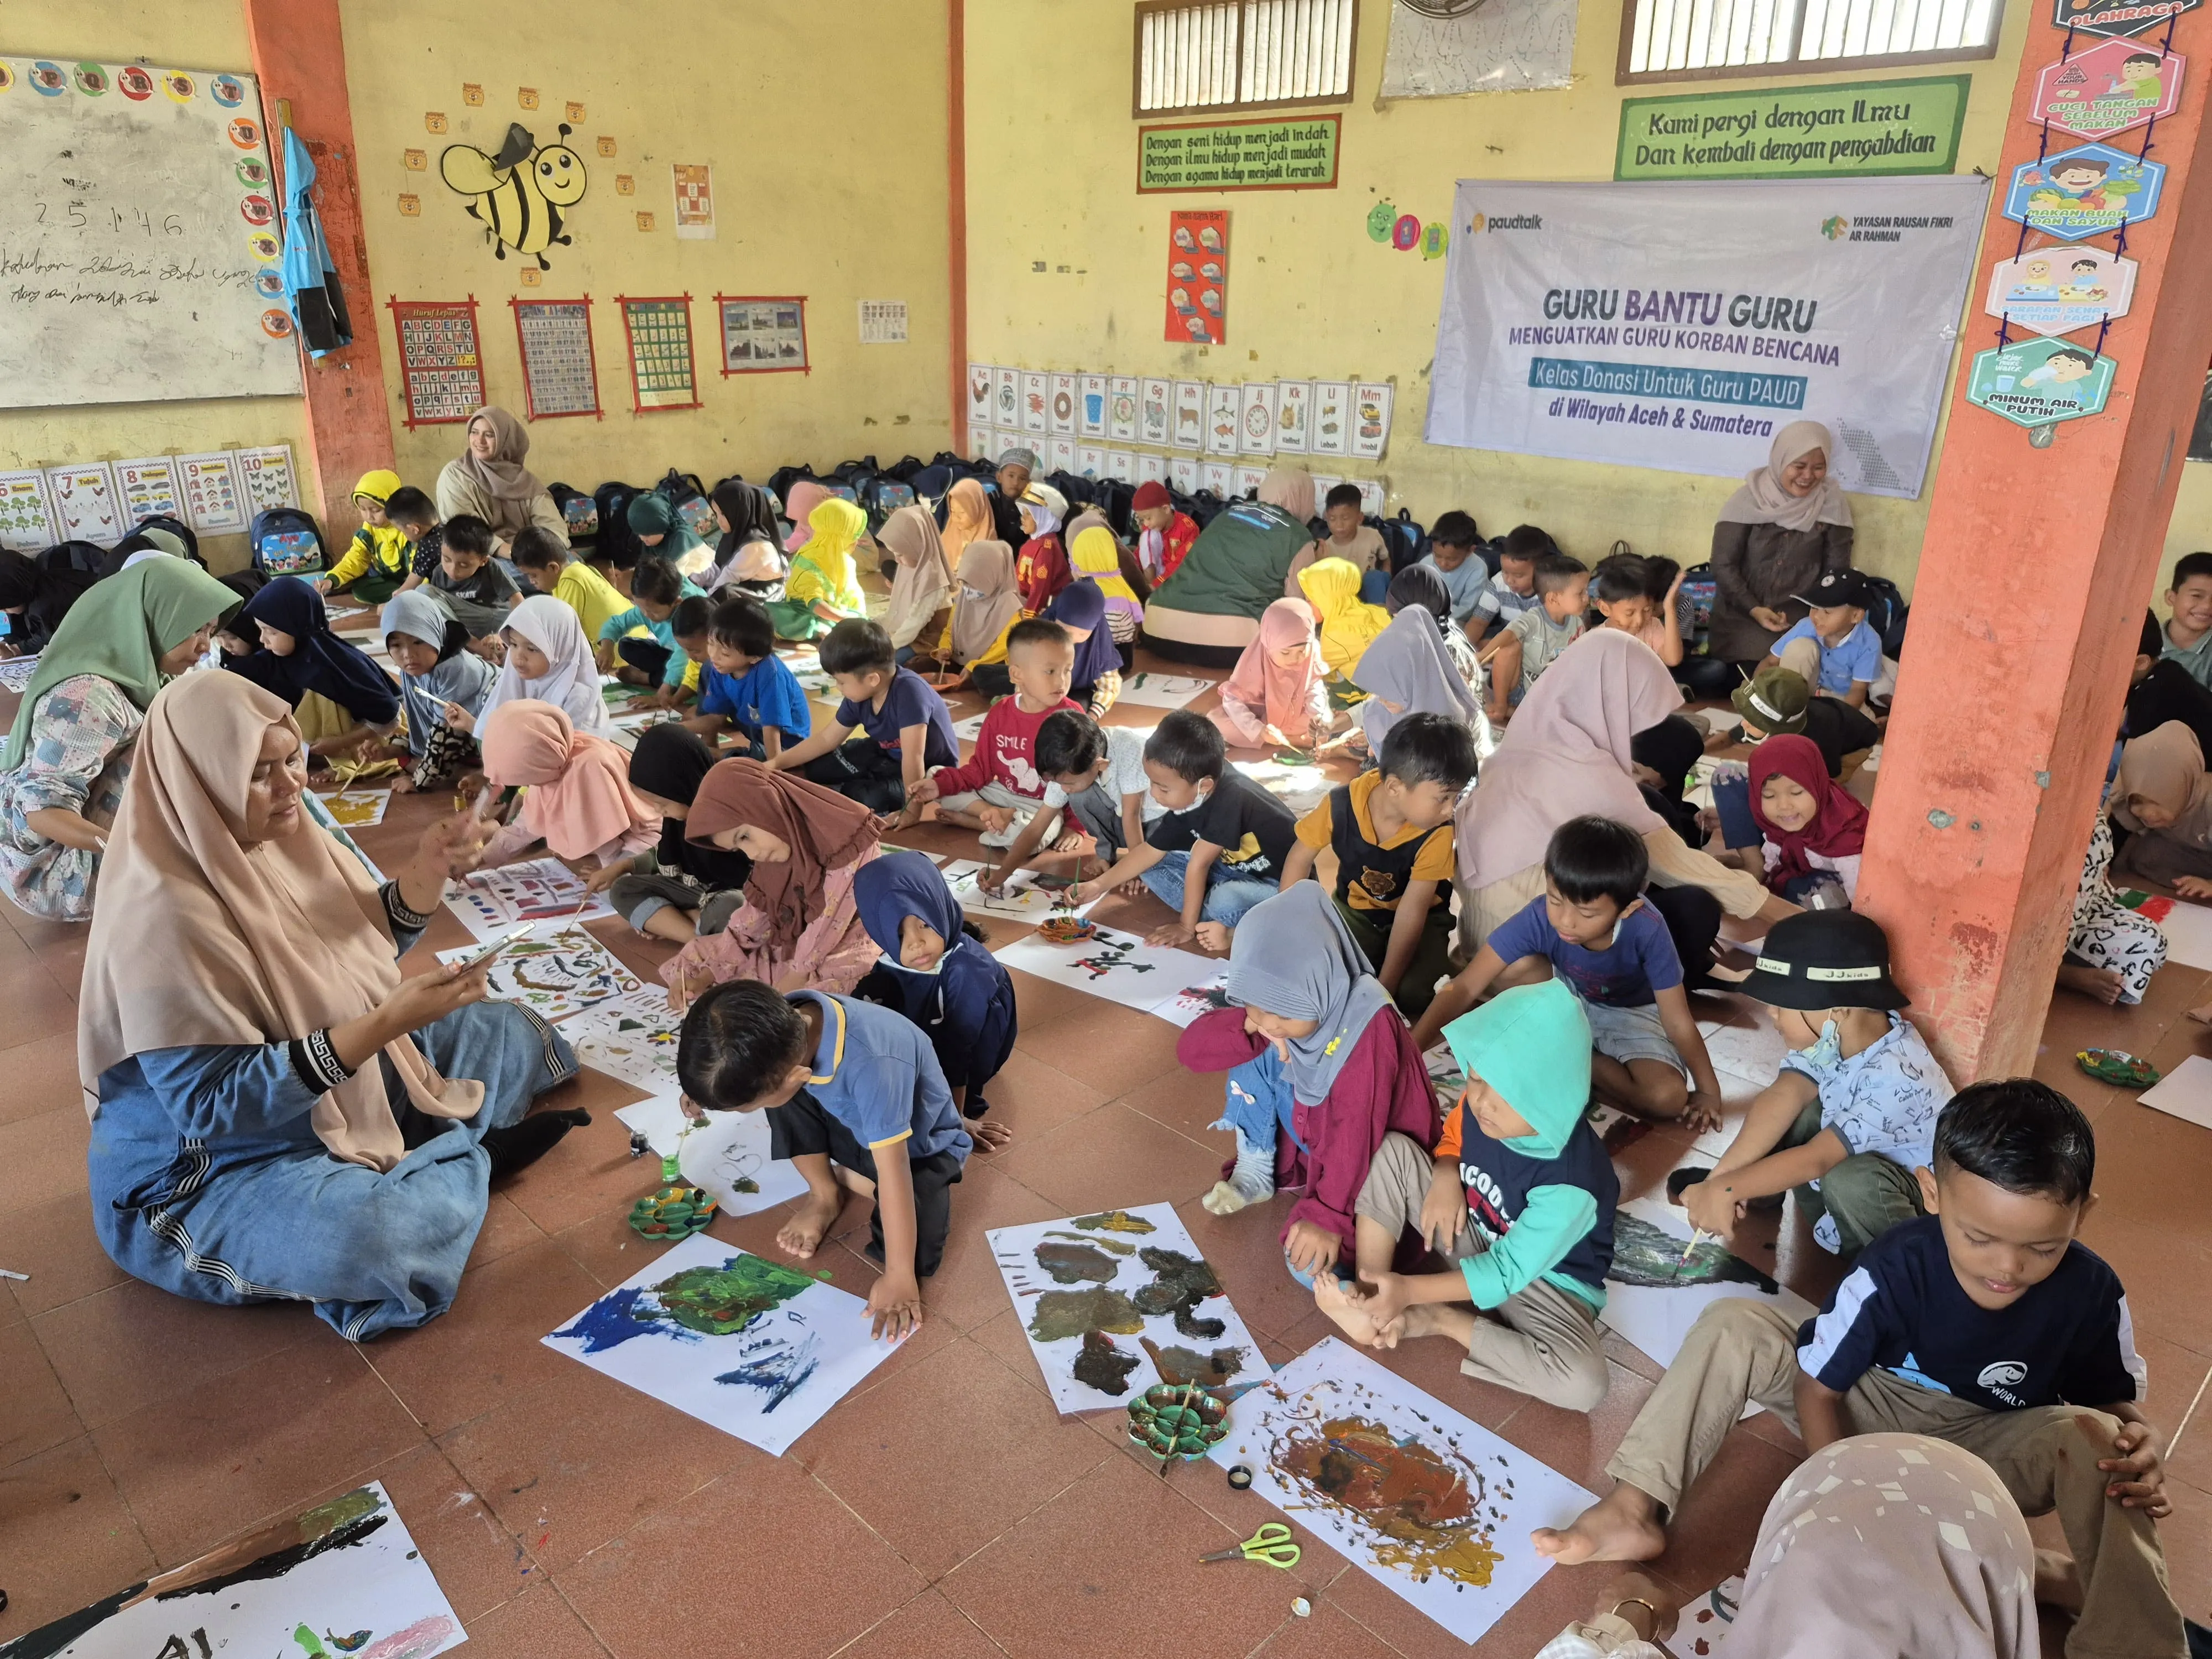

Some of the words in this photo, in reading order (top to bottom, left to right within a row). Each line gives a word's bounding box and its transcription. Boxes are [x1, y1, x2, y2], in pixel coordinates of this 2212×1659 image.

[2068, 2, 2184, 27] OLAHRAGA
[133, 75, 147, 88] R
[176, 77, 188, 92] S
[224, 86, 237, 98] T
[2047, 101, 2085, 112] CUCI
[2090, 97, 2158, 109] TANGAN
[1648, 113, 1698, 136] Kami
[1703, 112, 1756, 139] pergi
[1764, 103, 1844, 135] dengan
[2062, 109, 2138, 121] SEBELUM
[2068, 119, 2128, 130] MAKAN
[241, 127, 253, 139] U
[1146, 137, 1182, 153] Dengan
[1187, 134, 1209, 147] seni
[1213, 131, 1242, 149] hidup
[1293, 123, 1329, 140] indah
[1635, 145, 1676, 165] Dan
[1683, 140, 1755, 165] kembali
[1759, 137, 1827, 165] dengan
[1829, 130, 1936, 164] pengabdian
[1146, 153, 1182, 169] Dengan
[1185, 149, 1209, 164] ilmu
[1212, 148, 1240, 168] hidup
[1291, 143, 1326, 159] mudah
[249, 165, 261, 178] V
[1145, 170, 1182, 186] Dengan
[1186, 171, 1219, 185] agama
[1221, 166, 1245, 184] hidup
[1248, 164, 1282, 182] menjadi
[1286, 161, 1326, 178] terarah
[253, 206, 267, 215] W
[2025, 208, 2082, 217] MAKAN
[35, 203, 48, 223] 2
[68, 205, 87, 228] 5
[164, 215, 182, 236] 6
[1488, 213, 1543, 233] paudtalk
[1853, 216, 1891, 228] YAYASAN
[1893, 217, 1928, 228] RAUSAN
[1929, 217, 1953, 228] FIKRI
[2030, 217, 2065, 226] DAN
[2068, 217, 2120, 226] SAYUR
[1849, 231, 1861, 242] AR
[1863, 231, 1900, 242] RAHMAN
[1543, 288, 1619, 321] GURU
[1624, 290, 1723, 326] BANTU
[1728, 294, 1817, 333] GURU
[2000, 305, 2061, 314] SARAPAN
[2067, 306, 2111, 314] SEHAT
[275, 319, 285, 329] Z
[462, 321, 470, 329] G
[406, 346, 414, 354] O
[417, 346, 424, 354] P
[426, 345, 435, 354] Q
[1509, 326, 1618, 347] MENGUATKAN
[1622, 327, 1672, 349] GURU
[1674, 330, 1748, 355] KORBAN
[1751, 336, 1839, 366] BENCANA
[1031, 377, 1039, 387] Cc
[1060, 378, 1070, 388] Dd
[1089, 379, 1098, 390] Ee
[1535, 363, 1579, 387] Kelas
[1582, 367, 1639, 392] Donasi
[1643, 369, 1695, 397] Untuk
[1700, 374, 1746, 401] Guru
[1749, 378, 1801, 405] PAUD
[1152, 385, 1163, 399] Gg
[1185, 387, 1196, 399] Hh
[1256, 389, 1263, 403] Jj
[1288, 387, 1301, 399] Kk
[1361, 389, 1381, 401] Mm
[1989, 394, 2046, 406] MINUM
[2050, 399, 2078, 409] AIR
[1548, 396, 1563, 417] di
[1566, 397, 1626, 425] Wilayah
[1628, 403, 1668, 427] Aceh
[1672, 410, 1684, 429] &
[1688, 408, 1772, 437] Sumatera
[2006, 405, 2056, 417] PUTIH
[1321, 440, 1337, 449] Lebah
[1360, 442, 1378, 451] Mobil
[243, 458, 262, 471] 10
[1117, 457, 1125, 467] Ss
[188, 464, 199, 477] 9
[1178, 465, 1190, 476] Uu
[62, 476, 72, 489] 7
[126, 471, 138, 484] 8
[996, 734, 1028, 750] SMILE
